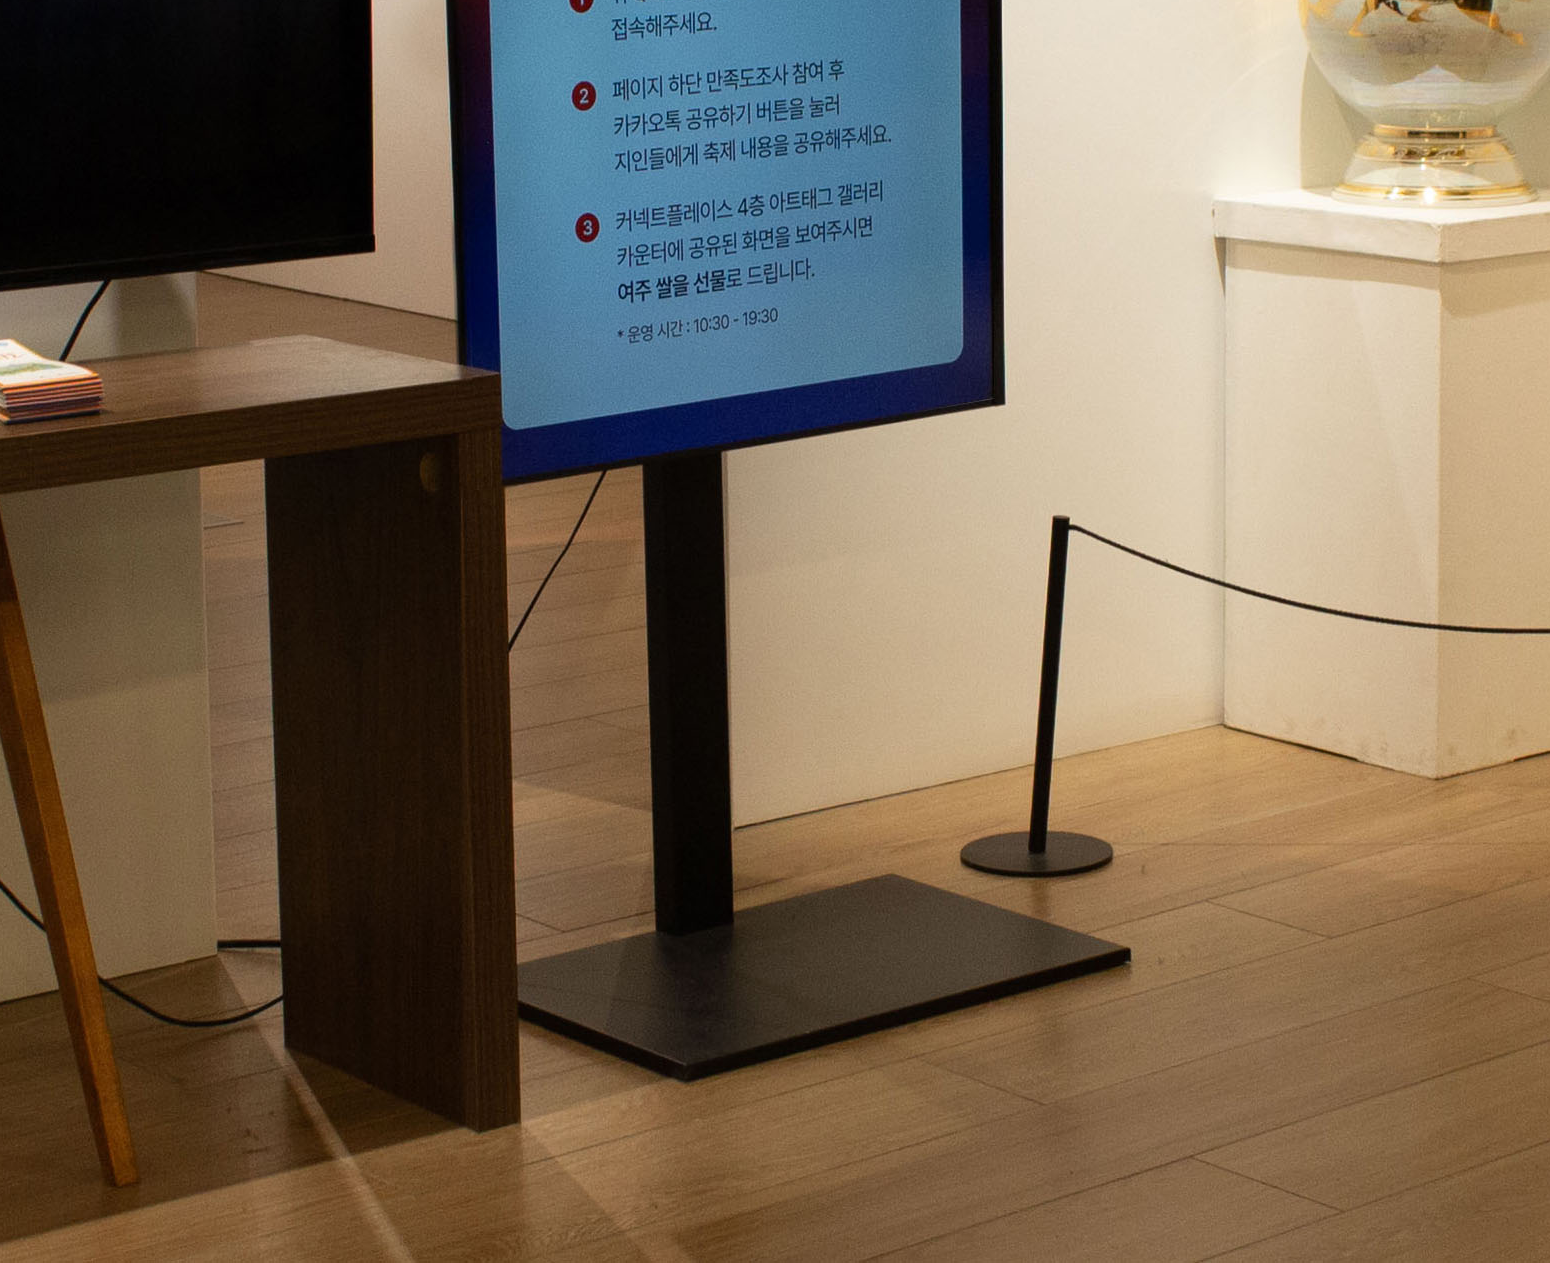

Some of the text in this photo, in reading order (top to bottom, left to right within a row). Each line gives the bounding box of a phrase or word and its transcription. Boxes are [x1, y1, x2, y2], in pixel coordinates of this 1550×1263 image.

[611, 11, 717, 41] 접속해주세요.
[612, 58, 845, 101] 페이지 하단 만족도조사 참여 후
[613, 92, 839, 138] 카카오톡 공유하기 버튼을 눌러
[614, 123, 892, 173] 지인들에게 축제 내용을 공유해주세요.
[615, 179, 883, 232] 커넥트플레이스 4층 아트태그 갤러리
[616, 214, 873, 268] 카운터에 공유된 화면을 보여주시면
[617, 257, 815, 304] 여주 쌀을 선물로 드립니다.
[626, 323, 653, 344] 운영
[656, 319, 683, 339] 시간
[693, 313, 729, 334] 10:30
[742, 307, 778, 326] 19:30
